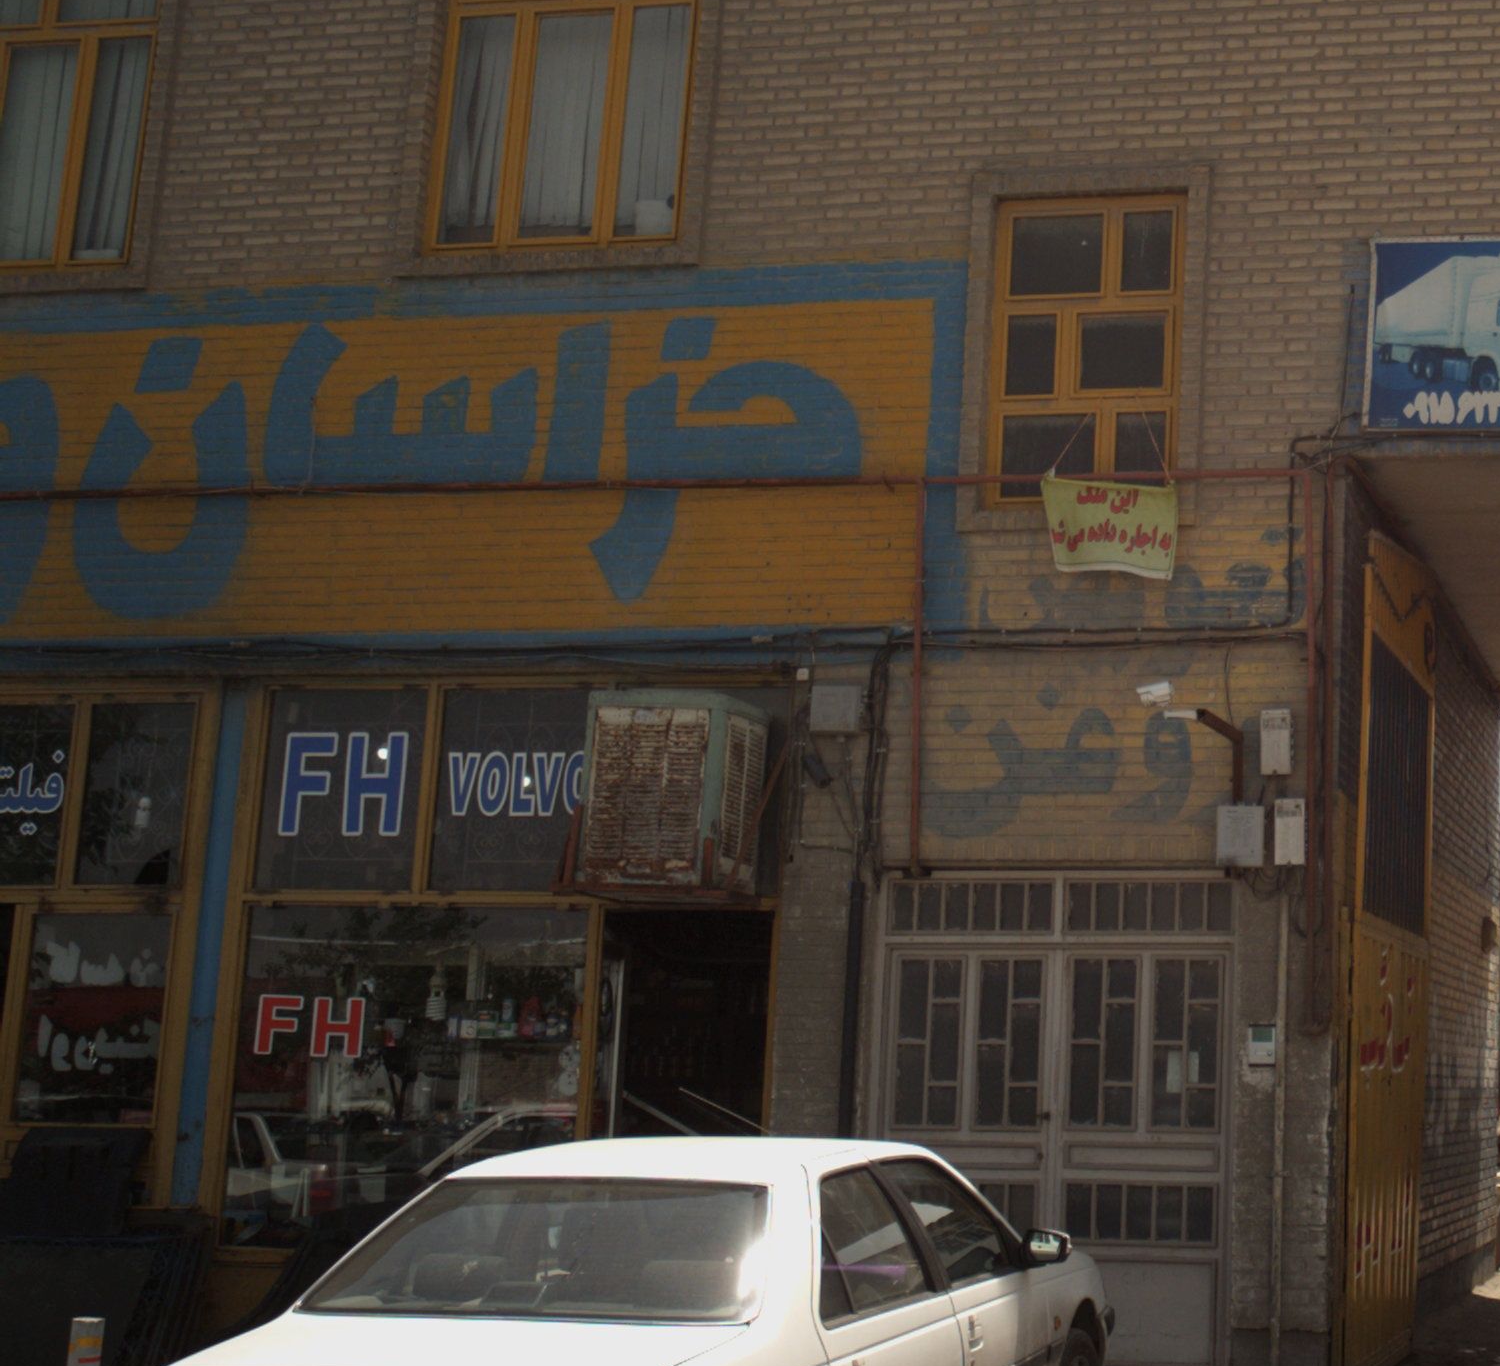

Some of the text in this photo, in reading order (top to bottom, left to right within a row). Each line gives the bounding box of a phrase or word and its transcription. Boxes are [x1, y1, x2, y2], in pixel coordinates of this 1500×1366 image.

[72, 315, 862, 620] خراسان
[1110, 488, 1139, 514] این
[1087, 518, 1117, 543] داده
[1119, 522, 1159, 556] اجاره
[1159, 531, 1172, 557] به
[0, 749, 66, 836] فیلت
[277, 731, 410, 837] FH
[253, 993, 366, 1059] FH
